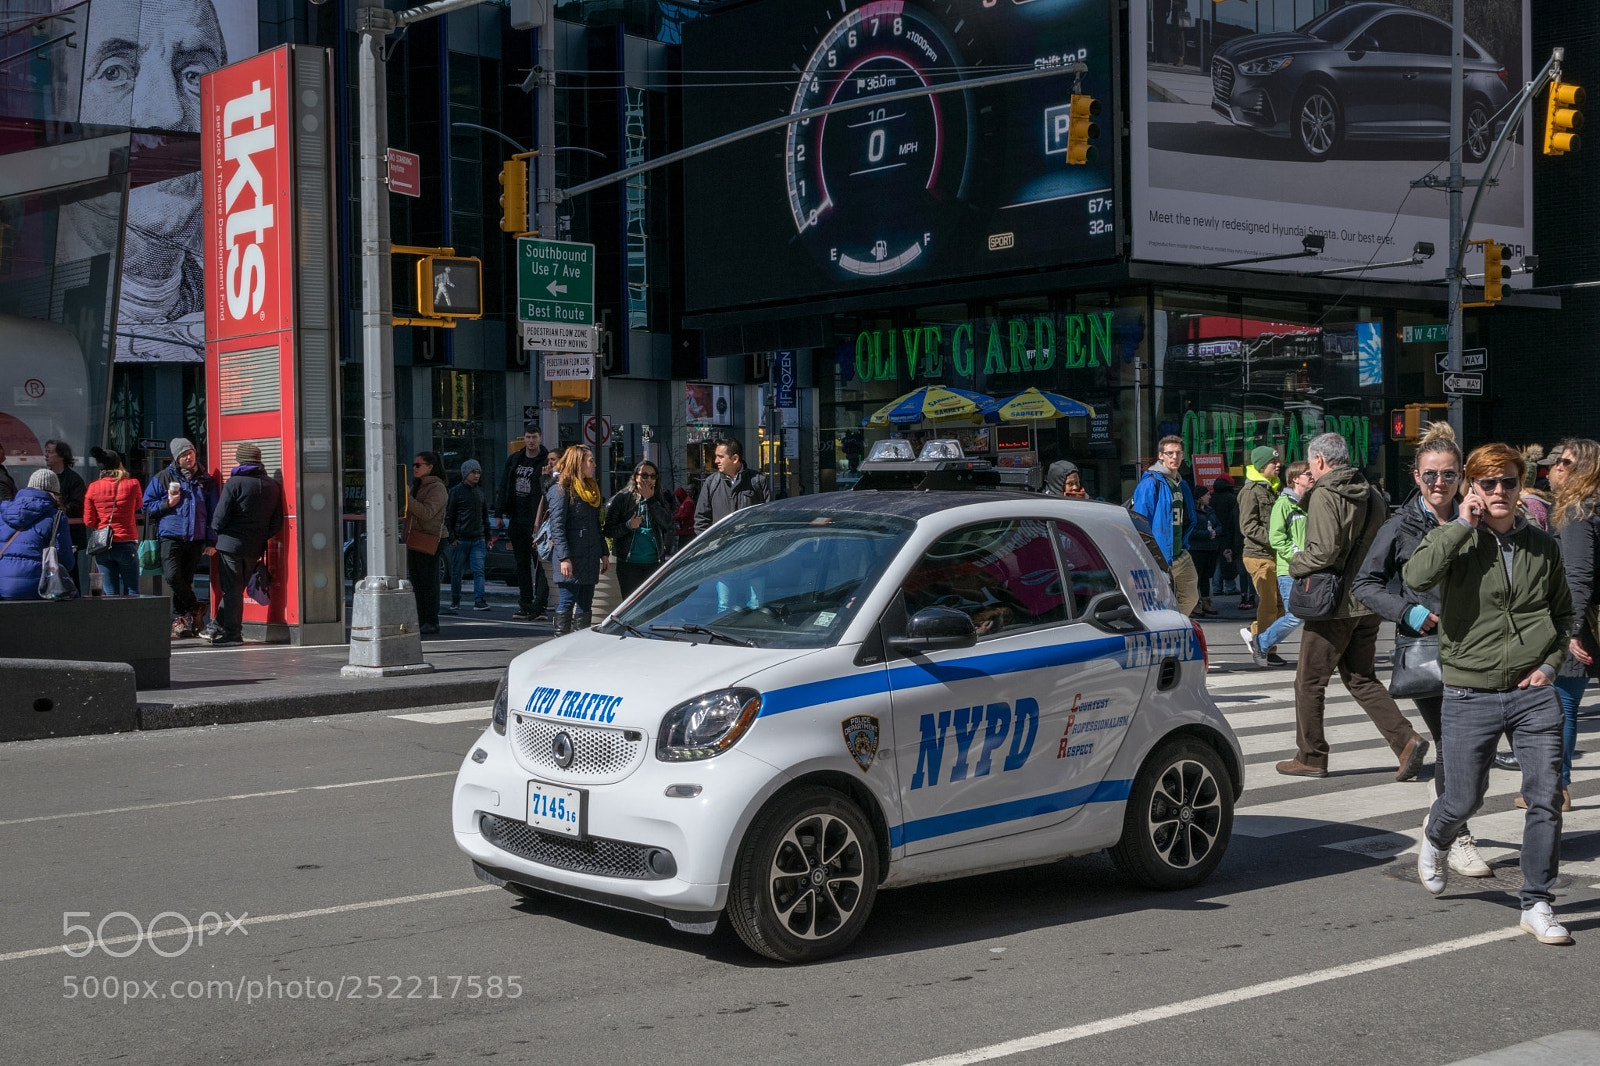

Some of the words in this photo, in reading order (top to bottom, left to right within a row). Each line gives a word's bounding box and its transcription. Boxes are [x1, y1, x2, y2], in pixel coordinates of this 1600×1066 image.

[871, 18, 880, 37] 7
[893, 17, 903, 36] 8
[848, 30, 858, 48] 6
[828, 50, 837, 68] 5
[810, 77, 820, 94] 4
[1055, 114, 1070, 143] P
[797, 144, 806, 162] 2
[868, 129, 886, 162] 0
[898, 141, 918, 155] MPH
[216, 158, 223, 169] of
[799, 180, 806, 197] 1
[1149, 210, 1173, 224] Meet
[1175, 213, 1191, 225] the
[1193, 216, 1220, 230] newly
[1222, 219, 1270, 235] redesigned
[1272, 223, 1307, 238] Hyundai
[1308, 226, 1338, 241] Sonata.
[1341, 229, 1356, 242] Our
[1357, 233, 1375, 244] best
[1377, 236, 1396, 246] ever.
[923, 233, 931, 246] F
[989, 234, 1013, 249] SPORT
[217, 218, 225, 291] Development
[526, 244, 587, 262] Southbound
[830, 249, 838, 261] E
[531, 261, 549, 276] Use
[552, 263, 559, 276] 7
[562, 264, 581, 278] Ave
[528, 303, 551, 318] Best
[555, 306, 585, 320] Route
[526, 327, 558, 337] PEDESTRIAN
[559, 328, 573, 338] FLOW
[574, 329, 588, 339] ZONE
[1414, 328, 1423, 340] W
[1426, 327, 1438, 340] 47
[554, 339, 567, 348] KEEP
[568, 340, 588, 349] MOVING
[855, 326, 944, 383] OLIVE
[952, 311, 1116, 377] GARDEN
[546, 358, 569, 367] PEDESTRIAN
[569, 358, 579, 366] FLOW
[579, 357, 590, 366] ZONE
[1464, 355, 1481, 365] WAY
[546, 368, 555, 377] KEEP
[556, 368, 571, 377] MOVING
[780, 351, 794, 400] FROZEN
[1448, 378, 1461, 387] ONE
[1466, 380, 1479, 389] WAY
[1181, 409, 1259, 468] OLIVE
[1124, 629, 1195, 668] TRAFFIC
[524, 686, 561, 714] NYPD
[556, 690, 624, 723] TRAFFIC
[850, 716, 871, 725] POLICE
[844, 723, 878, 736] DEPARTMENT
[910, 697, 1040, 790] NYPD
[533, 793, 565, 820] 7145
[566, 810, 577, 823] 16
